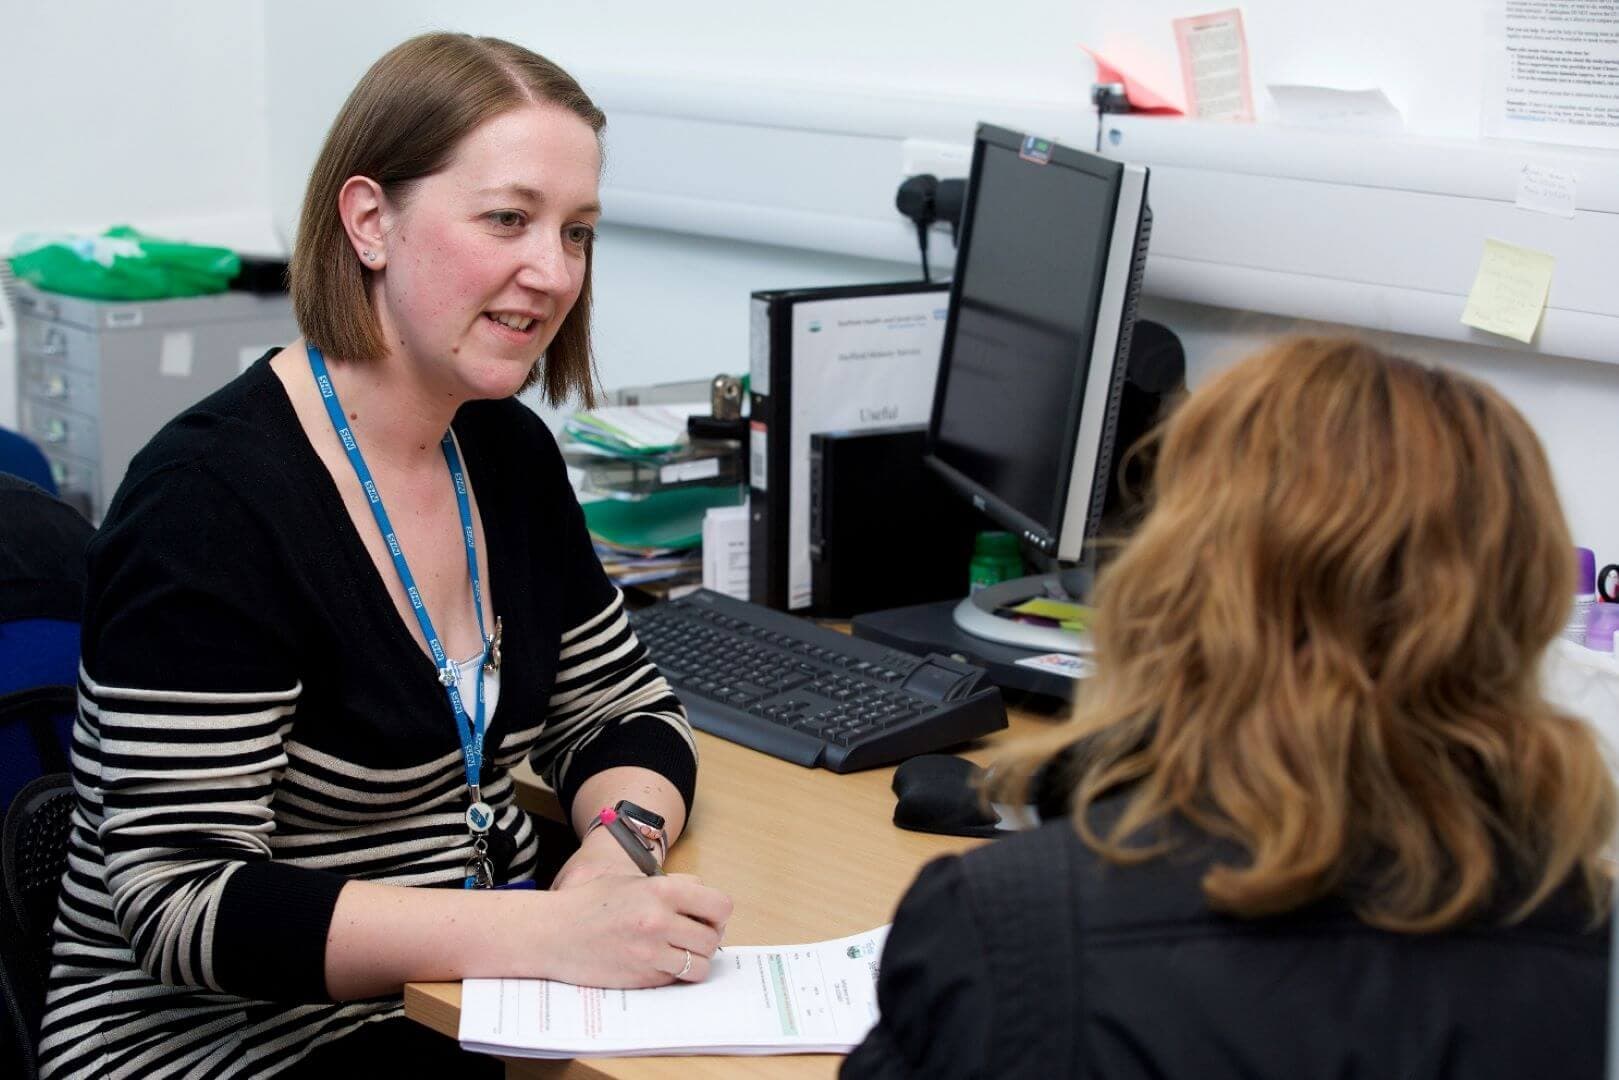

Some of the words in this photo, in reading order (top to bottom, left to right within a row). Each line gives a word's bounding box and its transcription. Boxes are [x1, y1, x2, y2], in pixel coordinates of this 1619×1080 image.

[318, 375, 334, 398] NHS
[340, 428, 356, 451] NHS
[364, 480, 379, 503] NHS
[386, 533, 400, 556] NHS
[408, 586, 422, 609] NHS
[431, 639, 444, 661] NHS
